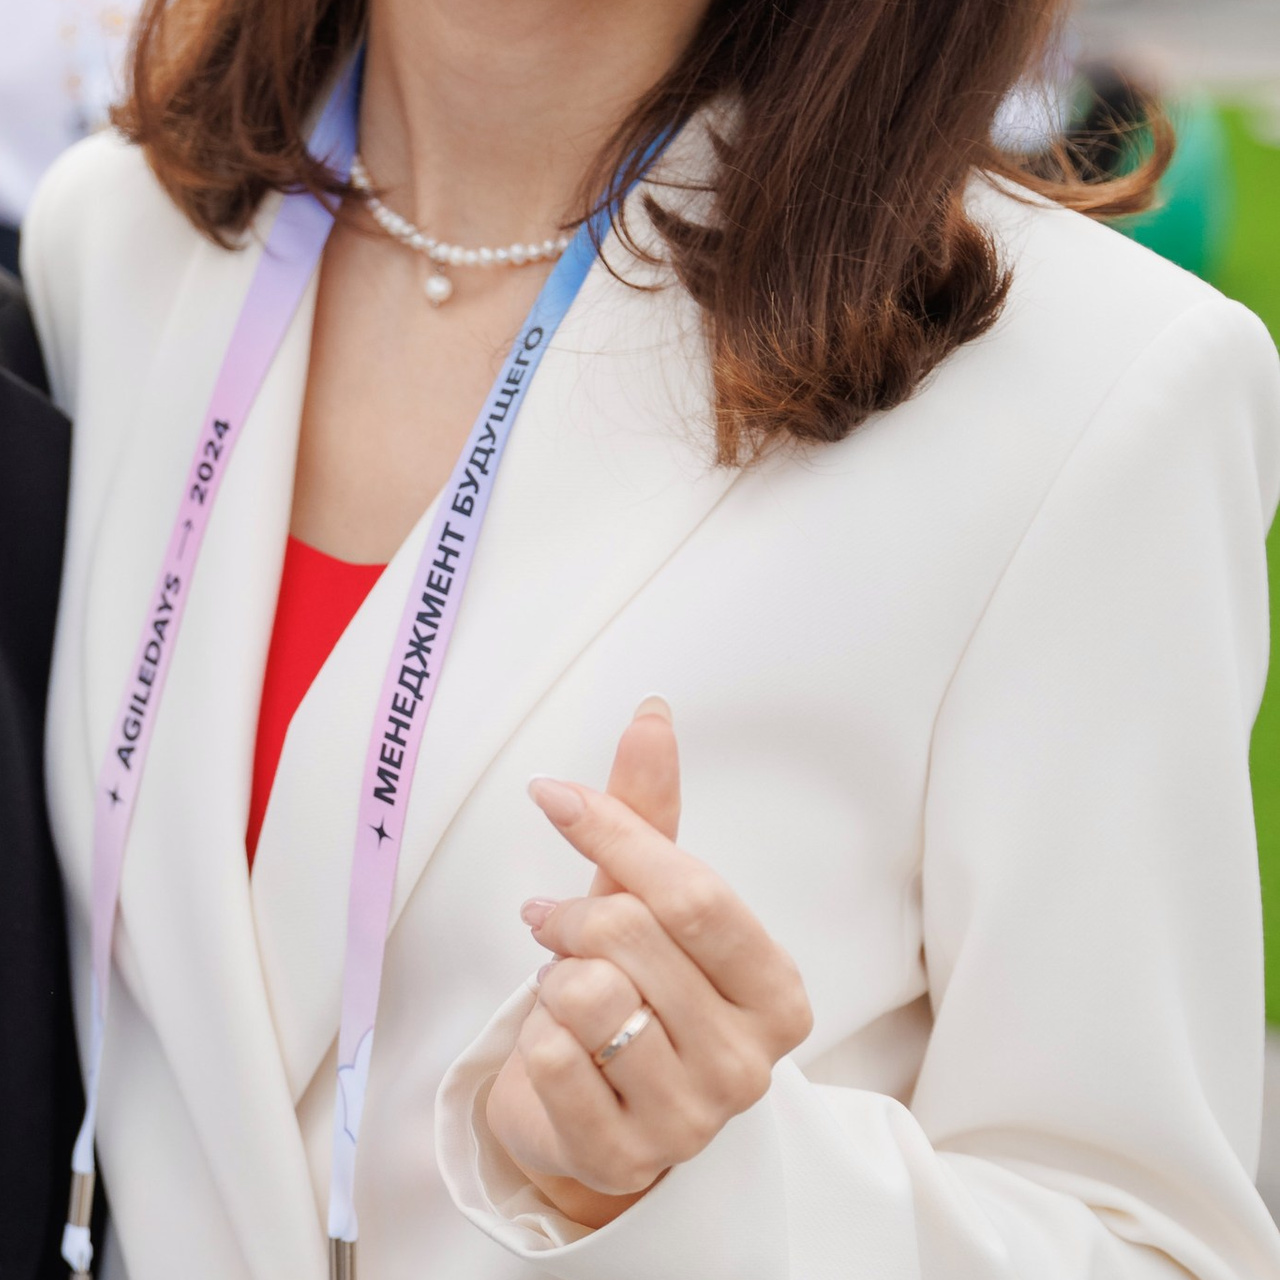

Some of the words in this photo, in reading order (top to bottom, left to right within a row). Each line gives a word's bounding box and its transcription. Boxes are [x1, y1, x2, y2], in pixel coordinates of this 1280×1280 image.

[116, 572, 182, 770] AGILEDAYS
[190, 417, 231, 507] 2024
[373, 522, 467, 806] МЕНЕДЖМЕНТ
[451, 325, 545, 518] БУДУЩЕГО
